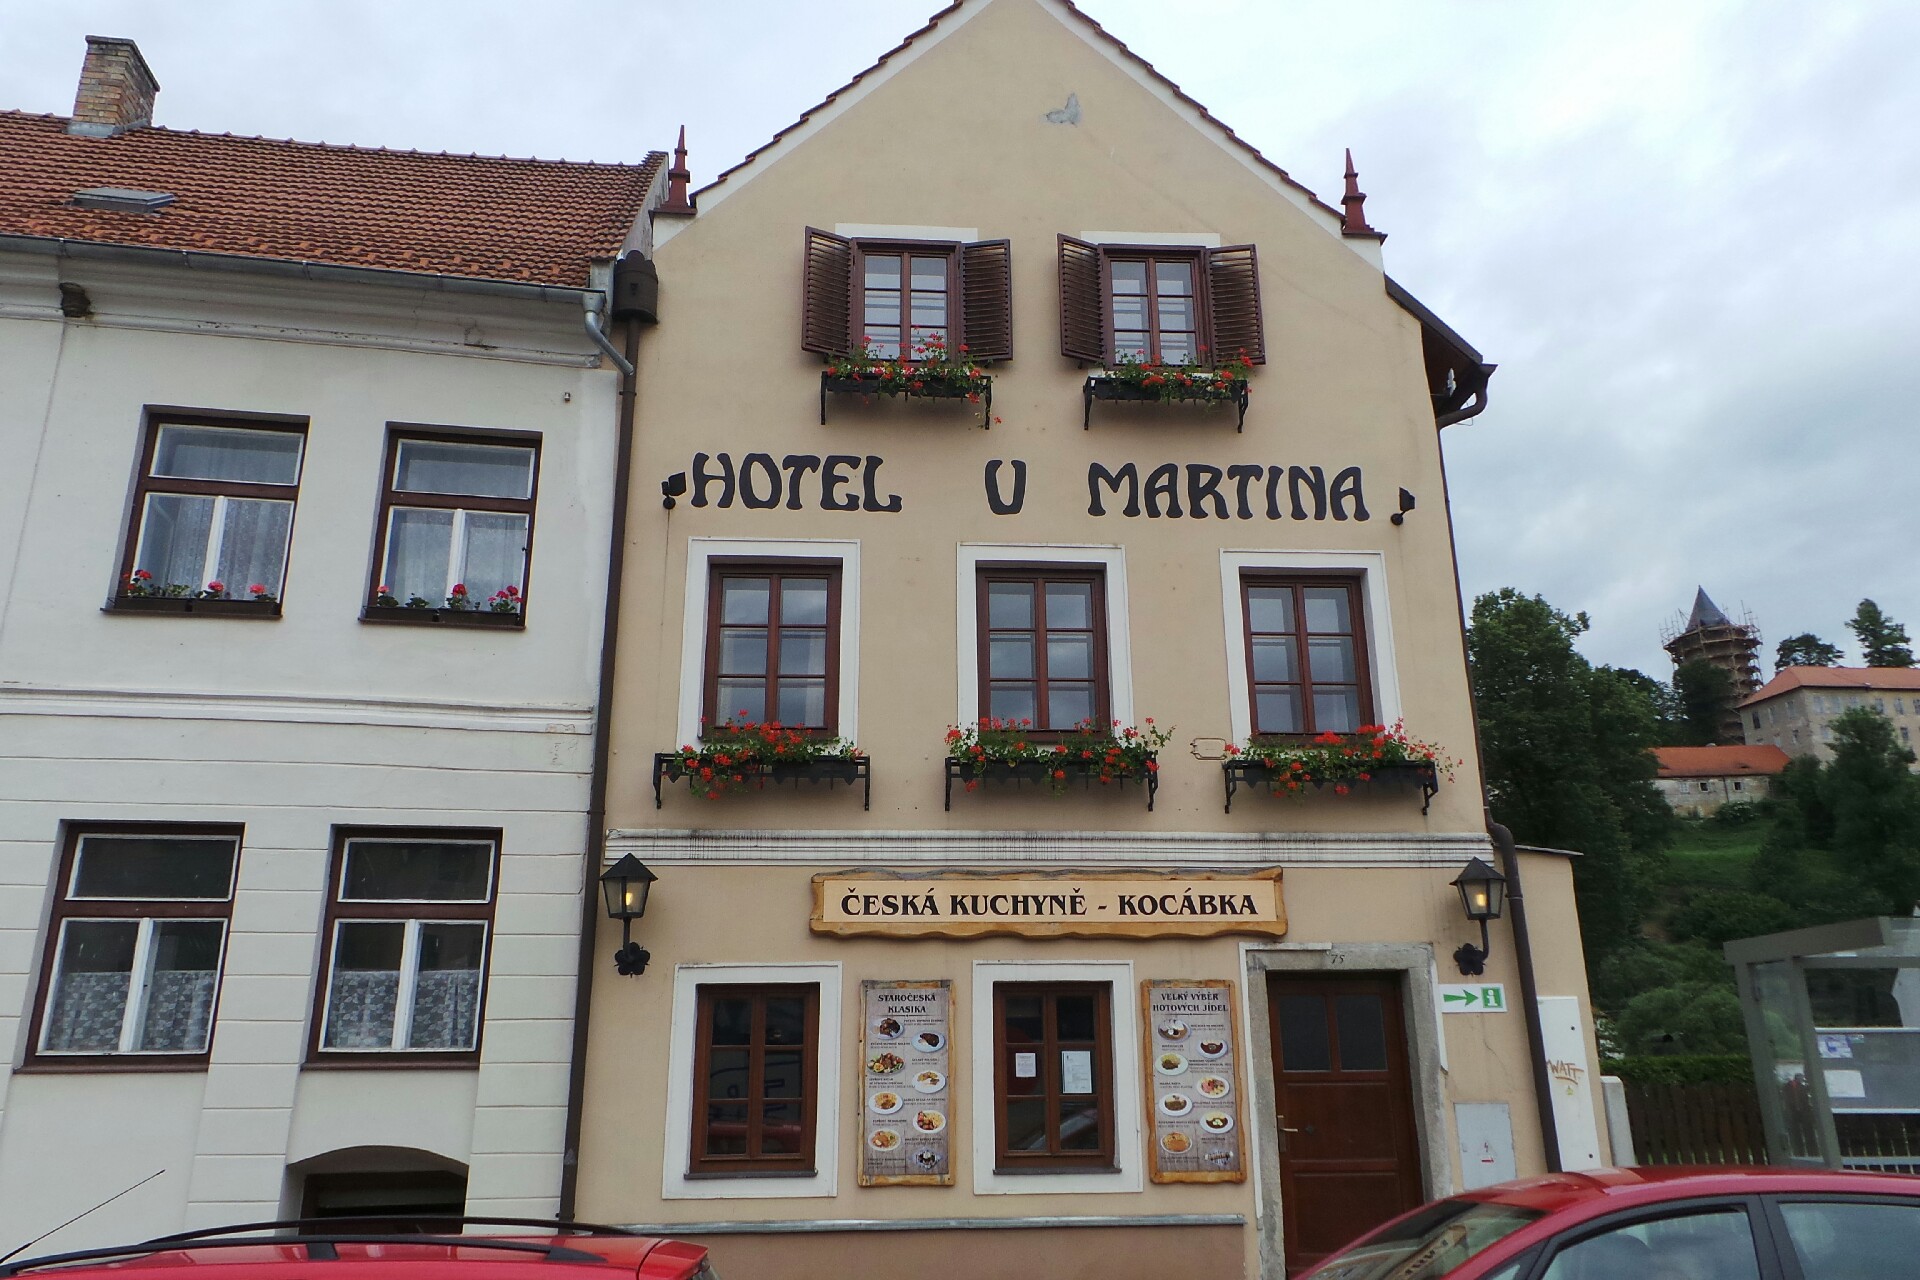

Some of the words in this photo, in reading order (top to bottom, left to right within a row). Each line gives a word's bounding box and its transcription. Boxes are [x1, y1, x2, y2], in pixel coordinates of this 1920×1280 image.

[691, 452, 902, 512] HOTEL
[985, 460, 1027, 515] U
[1088, 462, 1370, 521] MARTINA
[841, 887, 940, 915] ČESKÁ
[949, 887, 1087, 915] KUCHYNĚ
[1118, 887, 1258, 915] KOCÁBKA
[1330, 953, 1345, 964] 75
[878, 993, 936, 1002] STAROČESKÁ
[1161, 991, 1188, 1001] VELKÝ
[1190, 991, 1219, 1001] VÝBĚR
[888, 1005, 926, 1014] KLASIKA
[1153, 1002, 1200, 1012] HOTOVÝCH
[1203, 1002, 1228, 1012] JÍDEL
